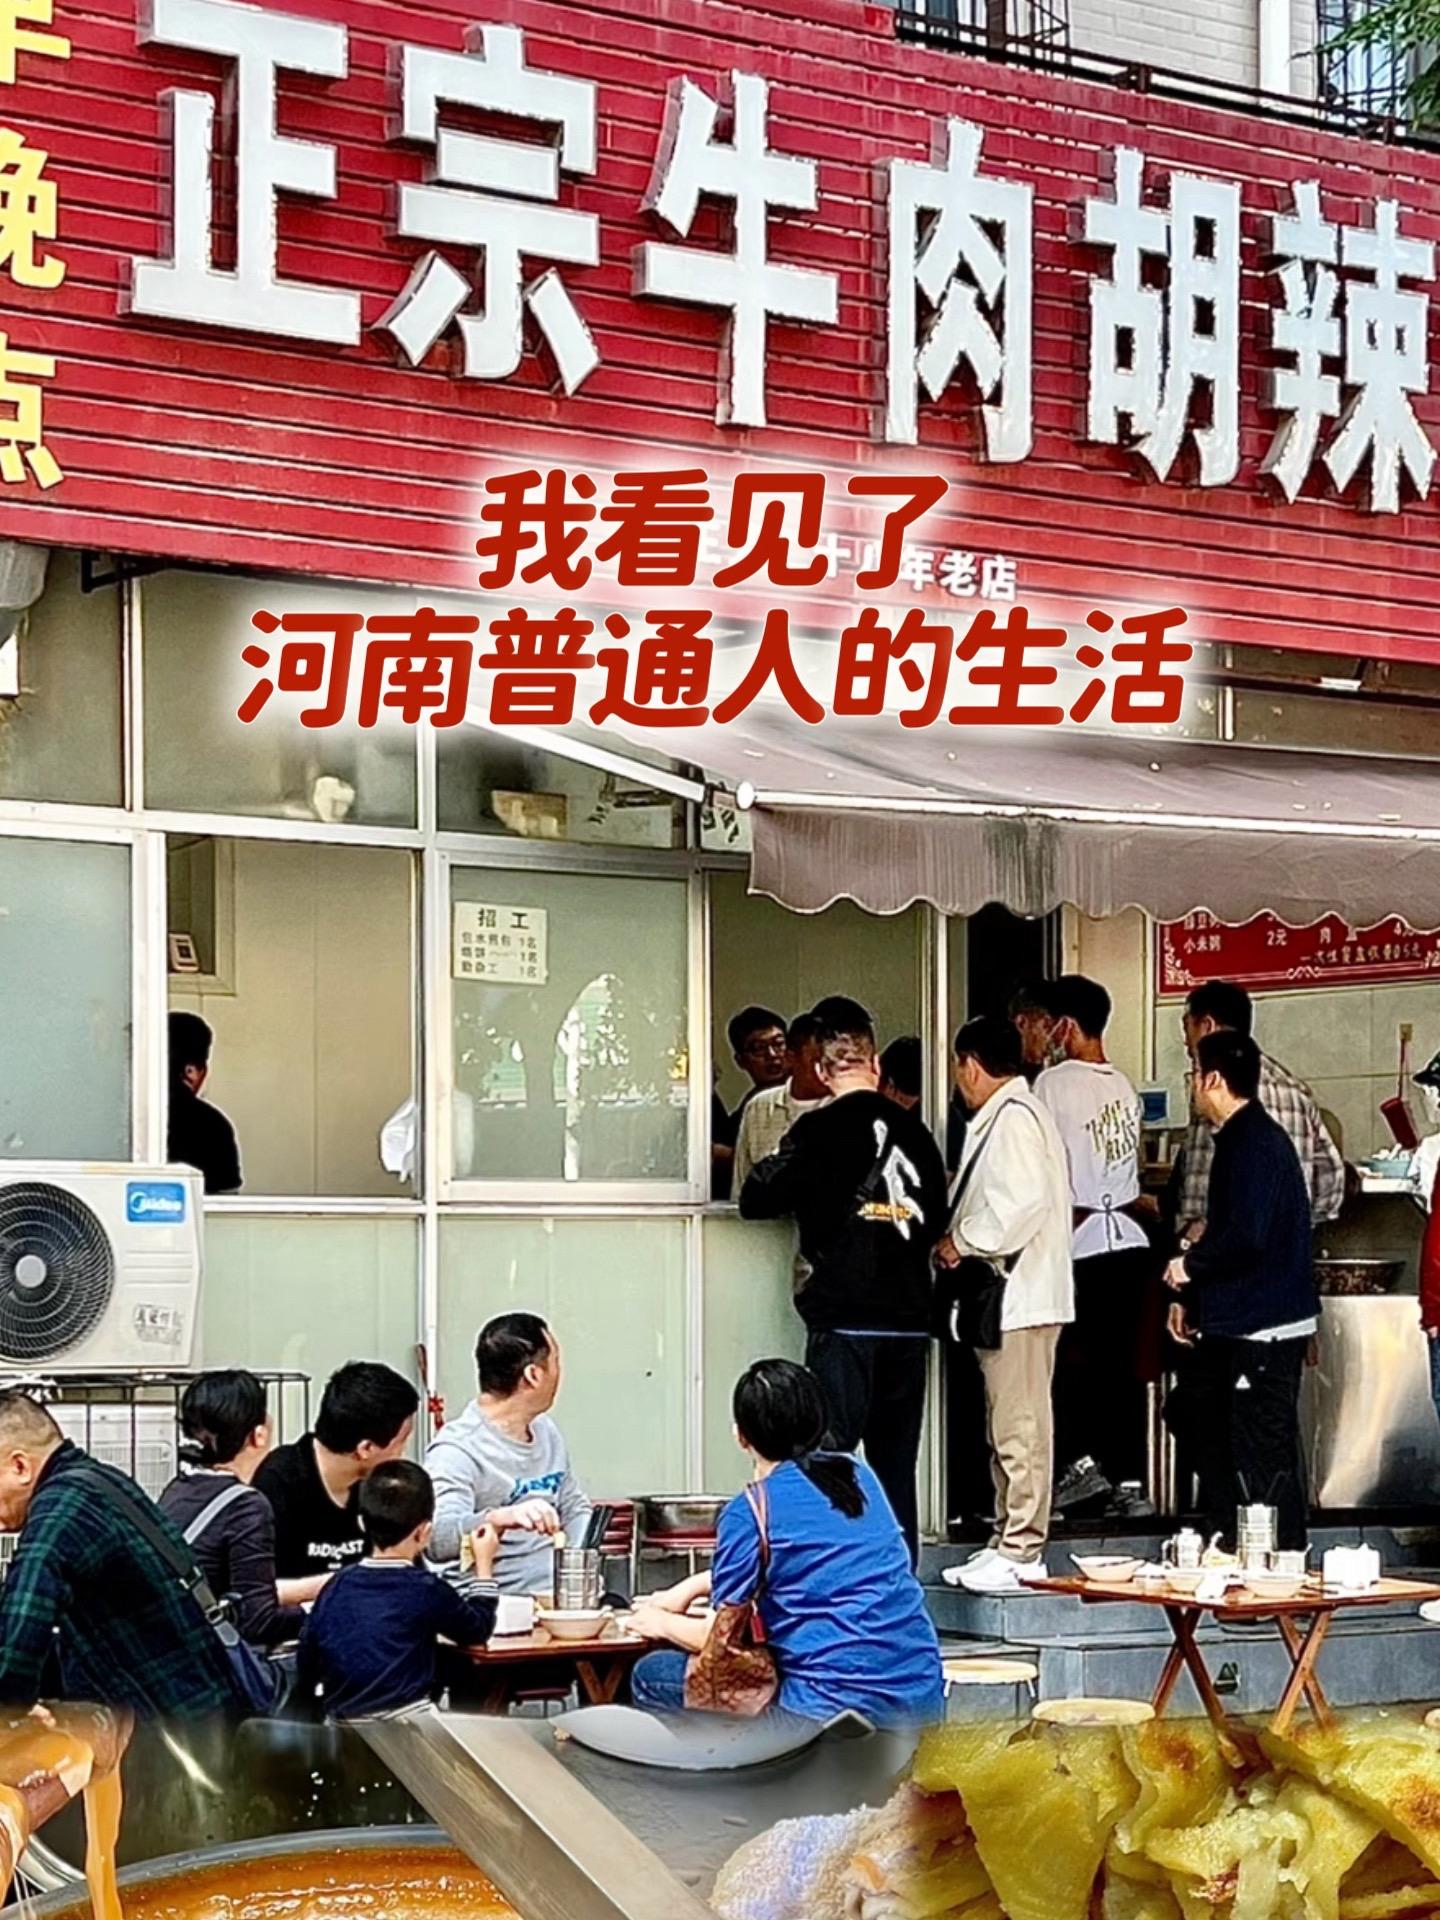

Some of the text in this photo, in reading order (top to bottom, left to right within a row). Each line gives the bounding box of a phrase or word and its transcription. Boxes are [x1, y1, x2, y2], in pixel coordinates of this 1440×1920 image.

[0, 0, 71, 488] 晚点
[123, 0, 1438, 514] 正宗牛肉胡辣
